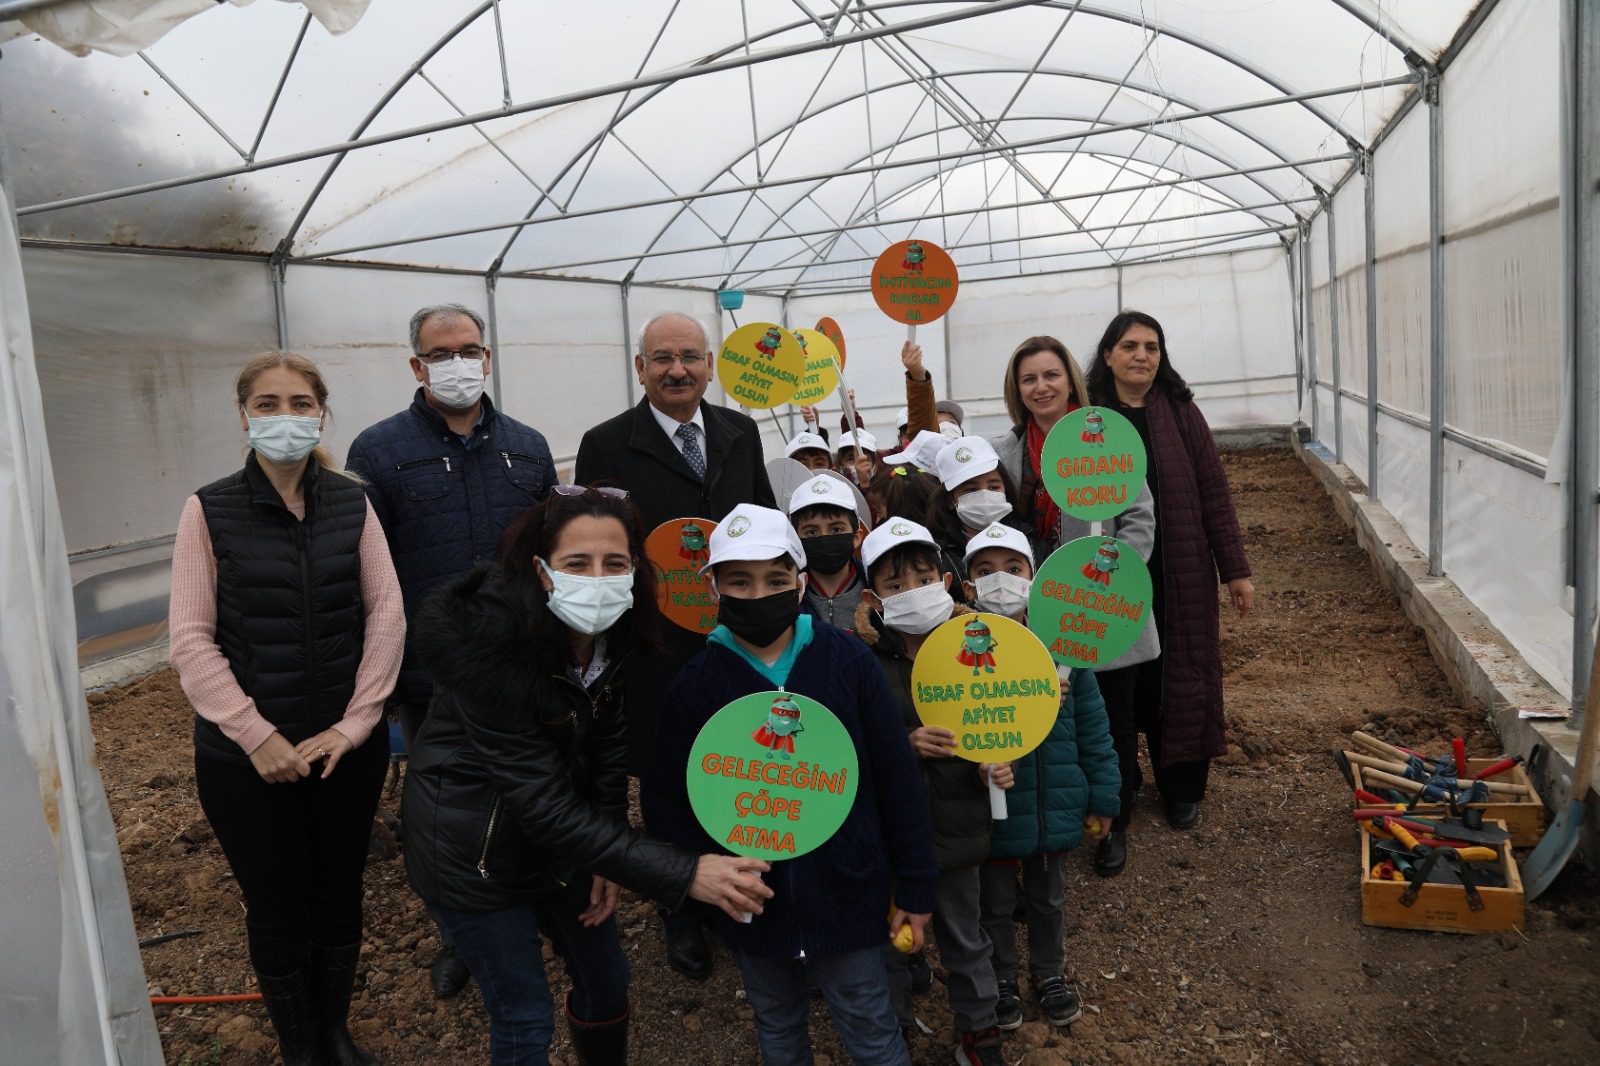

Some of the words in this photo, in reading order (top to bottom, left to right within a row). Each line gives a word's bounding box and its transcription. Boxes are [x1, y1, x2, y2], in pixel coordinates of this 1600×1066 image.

[879, 273, 951, 289] İHTİYACIN
[890, 292, 940, 305] KADAR
[905, 308, 923, 320] AL
[722, 346, 751, 366] İSRAF
[739, 371, 773, 390] AFİYET
[734, 384, 769, 405] OLSUN
[793, 386, 824, 400] OLSUN
[1056, 453, 1133, 479] GIDANI
[1066, 483, 1127, 508] KORU
[1041, 579, 1145, 623] GELECEĞİNİ
[1060, 611, 1108, 639] ÇÖPE
[1049, 637, 1098, 664] ATMA
[917, 682, 965, 703] İSRAF
[969, 678, 1056, 701] OLMASIN,
[962, 703, 1016, 725] AFİYET
[961, 731, 1023, 751] OLSUN
[702, 753, 848, 795] GELECEĞİNİ
[735, 789, 802, 821] ÇÖPE
[726, 823, 796, 854] ATMA
